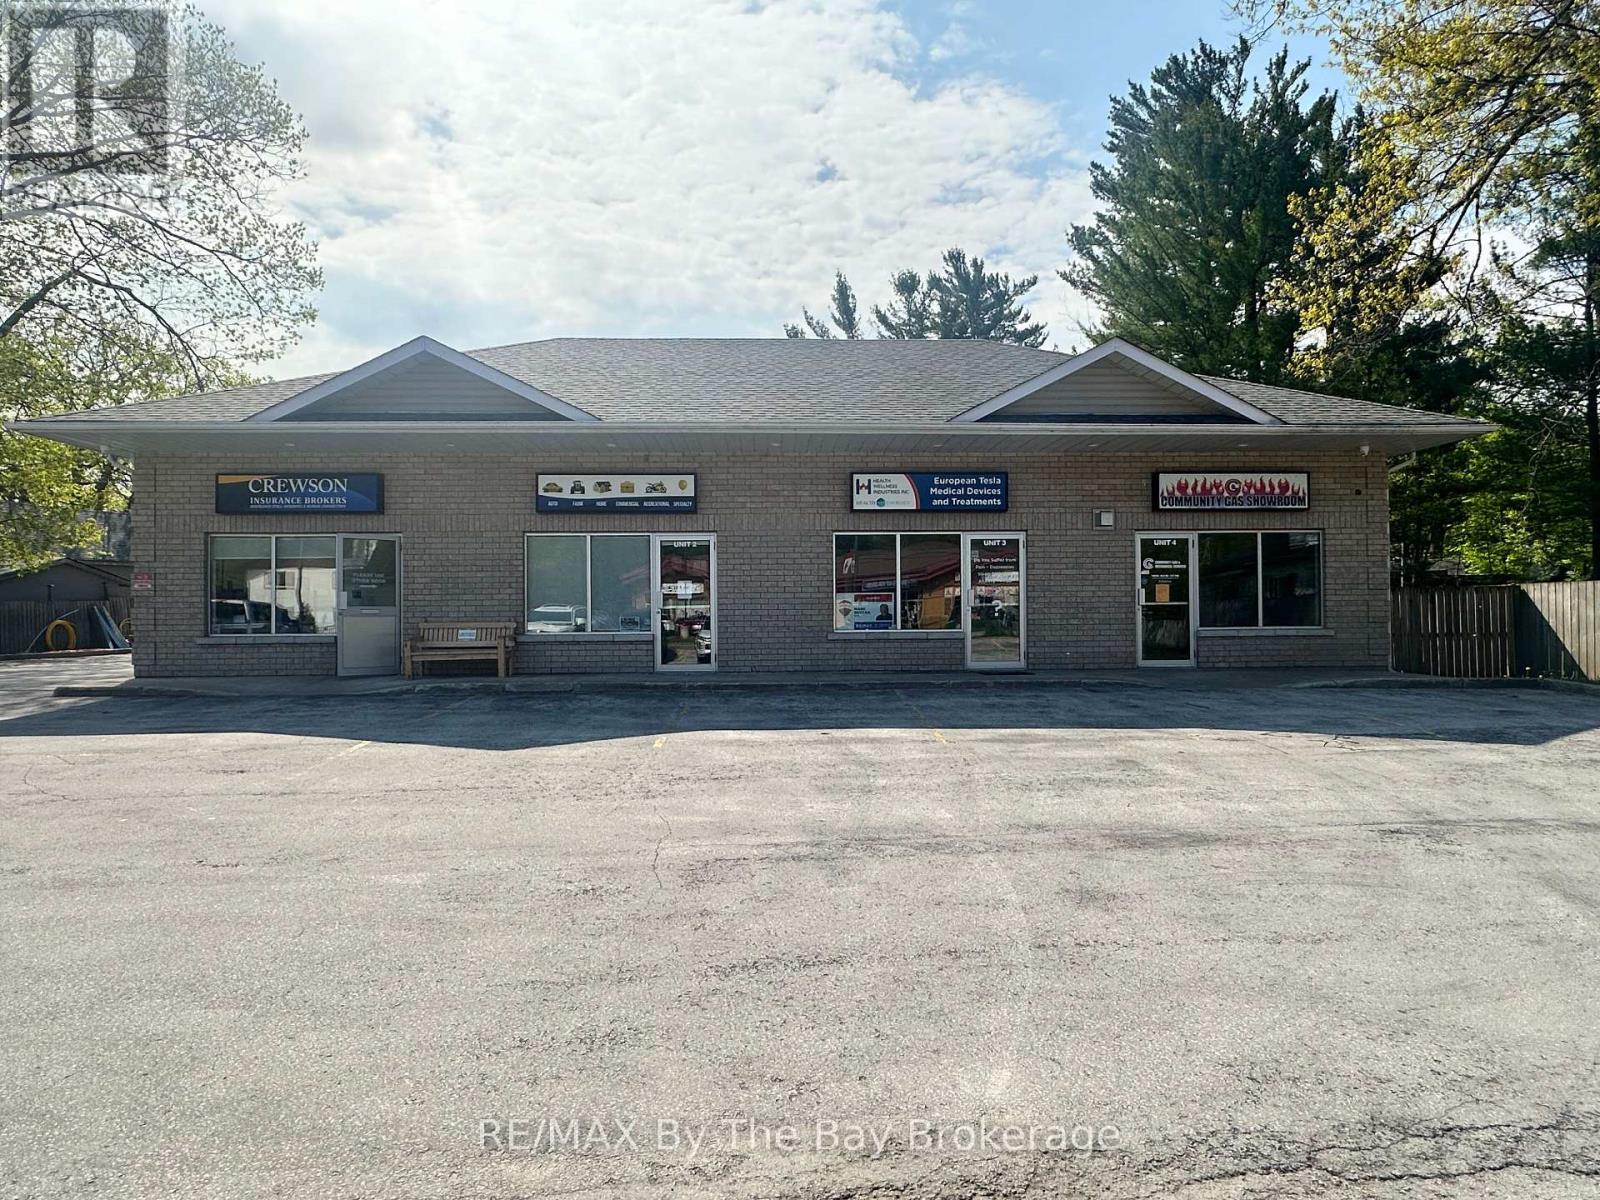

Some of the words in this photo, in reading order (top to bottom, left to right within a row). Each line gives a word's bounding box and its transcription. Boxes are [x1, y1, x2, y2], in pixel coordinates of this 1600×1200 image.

[248, 478, 348, 493] CREWSON
[933, 477, 976, 486] European
[978, 476, 1001, 484] Tesla
[930, 487, 964, 495] Medical
[966, 487, 1001, 495] Devices
[250, 496, 301, 505] INSURANCE
[304, 496, 347, 505] BROKERS
[932, 497, 949, 506] and
[951, 497, 1002, 506] Treatments
[1160, 495, 1222, 507] COMMUNITY
[1224, 495, 1244, 507] GAS
[1247, 495, 1306, 507] SHOWROOM
